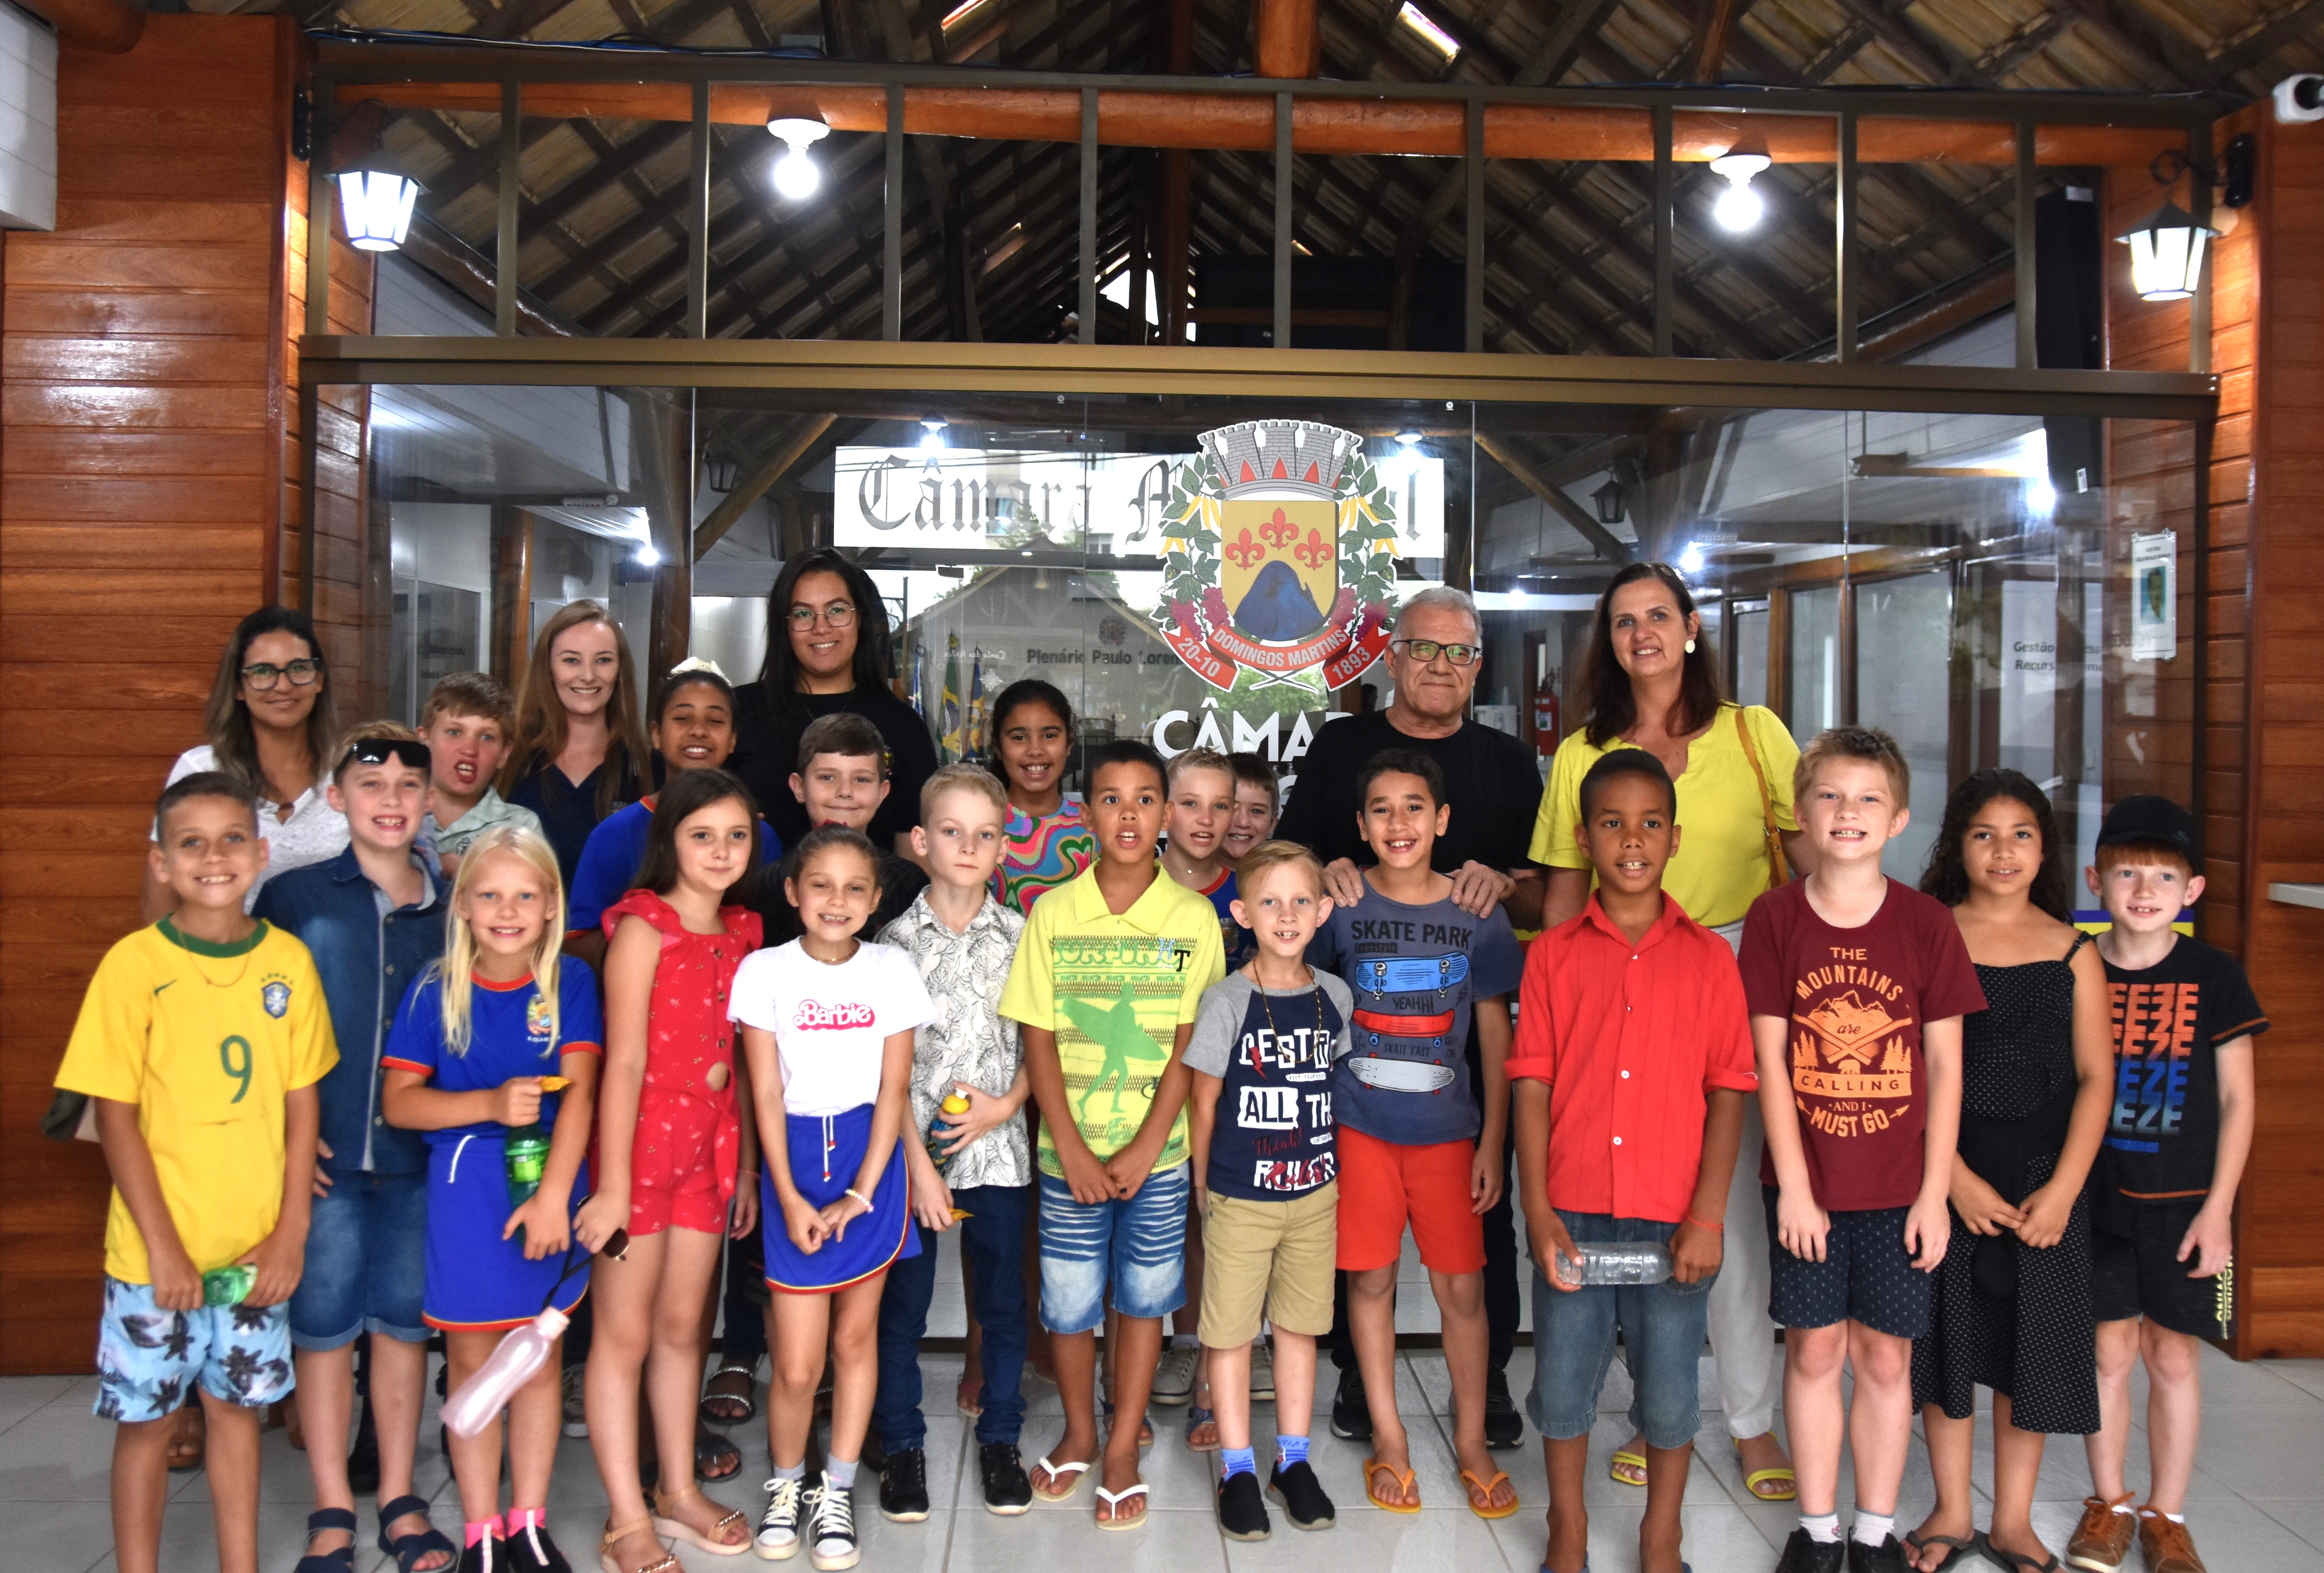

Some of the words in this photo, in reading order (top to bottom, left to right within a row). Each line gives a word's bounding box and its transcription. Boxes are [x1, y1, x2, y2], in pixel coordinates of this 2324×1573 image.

[858, 455, 1093, 533] Câmara
[1092, 649, 1132, 665] Paulo
[1139, 650, 1182, 665] Loren
[1177, 637, 1221, 677] 20-10
[1213, 628, 1284, 667] DOMINGOS
[1288, 629, 1347, 667] MARTINS
[2014, 641, 2055, 653] Gestão
[1332, 647, 1371, 680] 1893
[2015, 660, 2055, 671] Recurs
[1351, 919, 1416, 942] SKATE
[1422, 923, 1473, 950] PARK
[1830, 947, 1867, 960] THE
[1796, 965, 1903, 1001] MOUNTAINS
[793, 999, 875, 1030] Barbie
[1393, 995, 1434, 1014] YEAHH!
[1837, 1023, 1861, 1035] are
[1384, 1042, 1407, 1055] SKATE
[1410, 1044, 1430, 1058] FAST
[220, 1034, 253, 1105] 9
[1802, 1075, 1900, 1091] CALLING
[1243, 1090, 1294, 1123] ALL
[1305, 1092, 1332, 1128] TH
[1810, 1106, 1858, 1137] MUST
[1862, 1108, 1890, 1134] GO
[1833, 1102, 1860, 1112] AND
[1861, 1102, 1867, 1111] I
